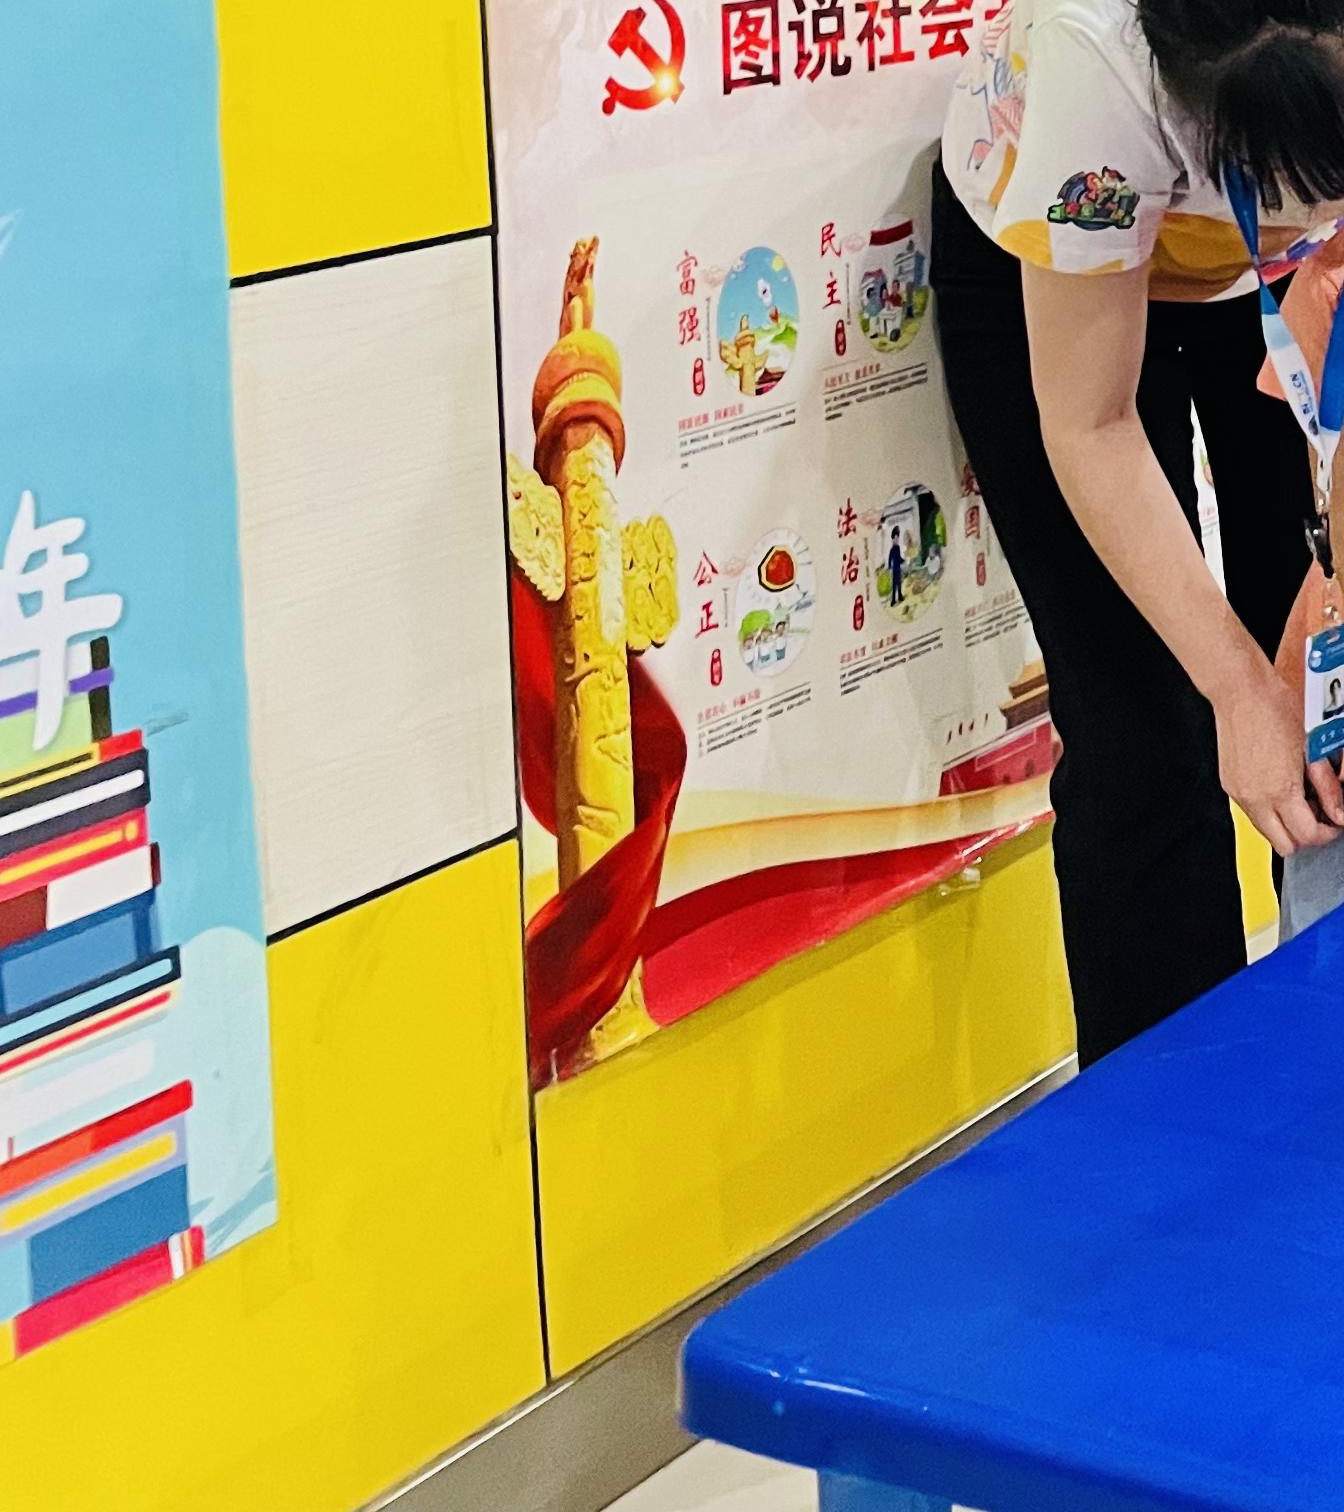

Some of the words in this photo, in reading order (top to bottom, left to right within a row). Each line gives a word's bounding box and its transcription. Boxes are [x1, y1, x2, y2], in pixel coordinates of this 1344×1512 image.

[676, 250, 699, 345] 富强
[820, 222, 842, 309] 民主
[837, 497, 860, 585] 法治
[693, 550, 719, 639] 公正
